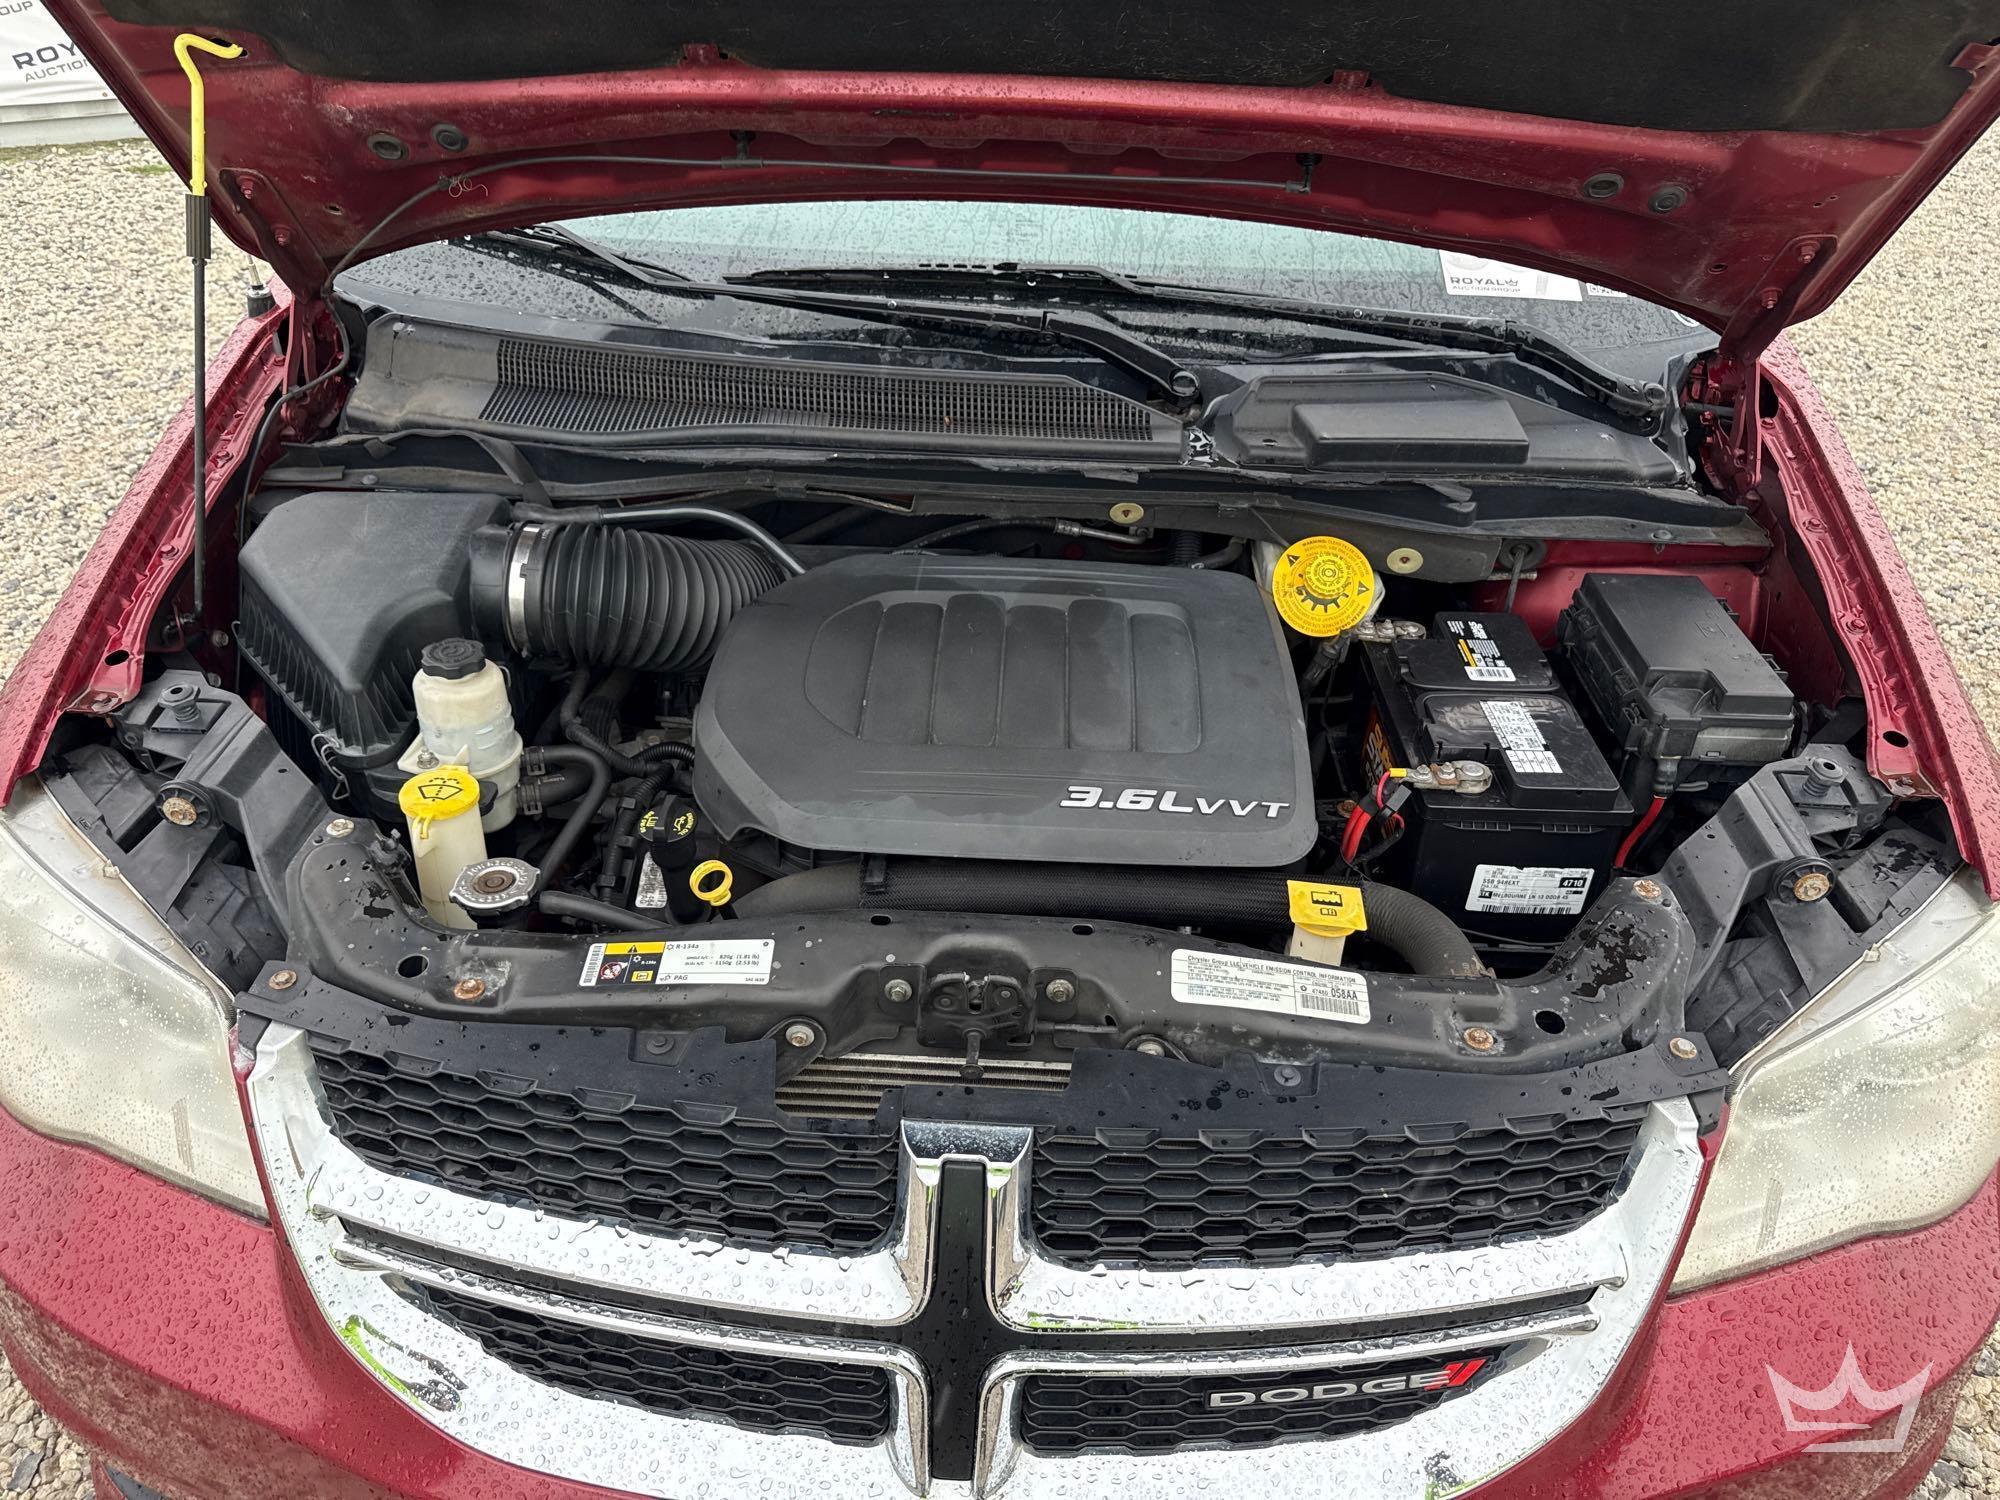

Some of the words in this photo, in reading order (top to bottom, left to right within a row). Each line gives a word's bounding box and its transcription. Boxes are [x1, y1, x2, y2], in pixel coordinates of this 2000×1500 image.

[1450, 276, 1505, 287] ROYAL
[1187, 955, 1210, 963] Chrysler
[1211, 957, 1228, 966] Group
[1209, 1369, 1451, 1408] DODGE
